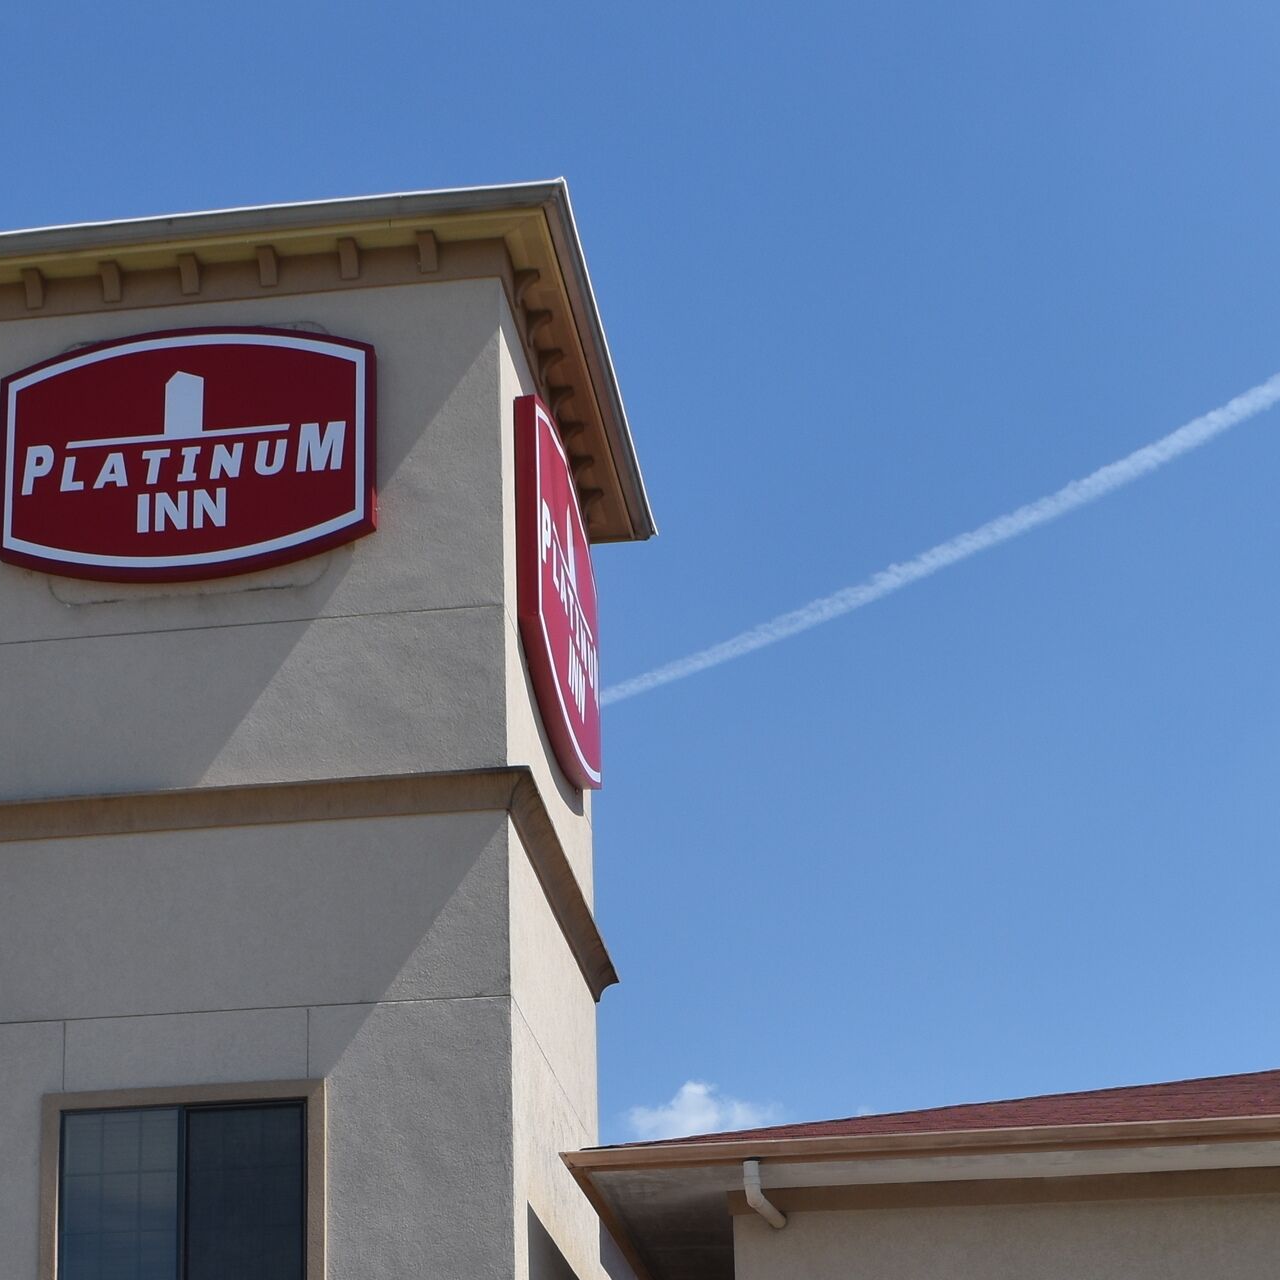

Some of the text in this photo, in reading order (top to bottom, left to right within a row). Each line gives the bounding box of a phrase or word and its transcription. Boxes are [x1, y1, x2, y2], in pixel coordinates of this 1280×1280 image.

[21, 420, 347, 496] PLATINUM
[136, 487, 227, 533] INN
[568, 634, 586, 725] INN
